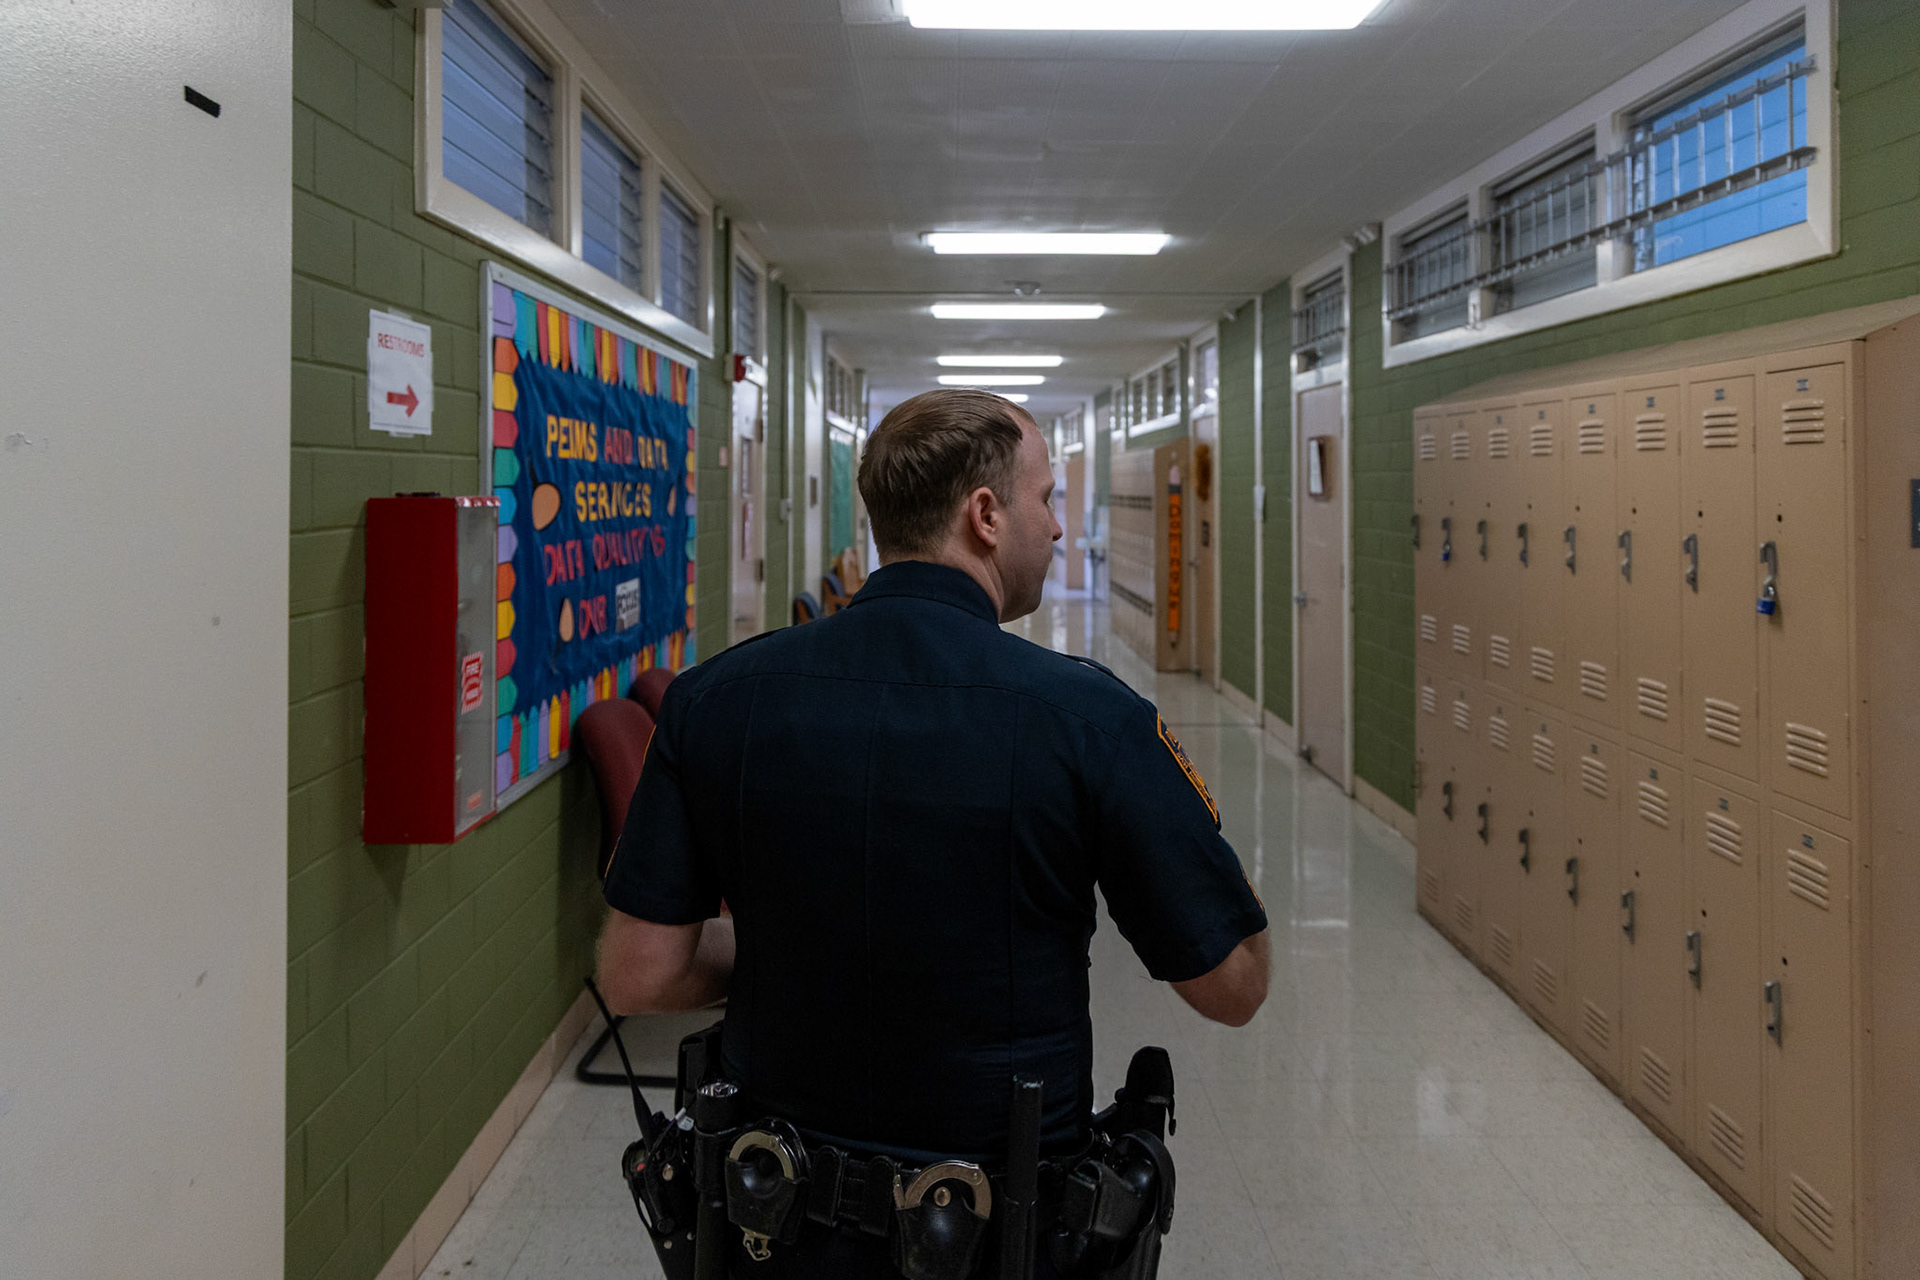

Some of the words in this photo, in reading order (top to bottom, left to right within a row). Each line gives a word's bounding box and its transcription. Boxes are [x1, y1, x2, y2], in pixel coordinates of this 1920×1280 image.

[377, 332, 424, 358] RESTROOMS
[546, 414, 598, 462] PEIMS
[604, 426, 633, 465] AND
[638, 436, 669, 471] DATA
[543, 539, 585, 587] DATA
[592, 526, 648, 572] QUALITY
